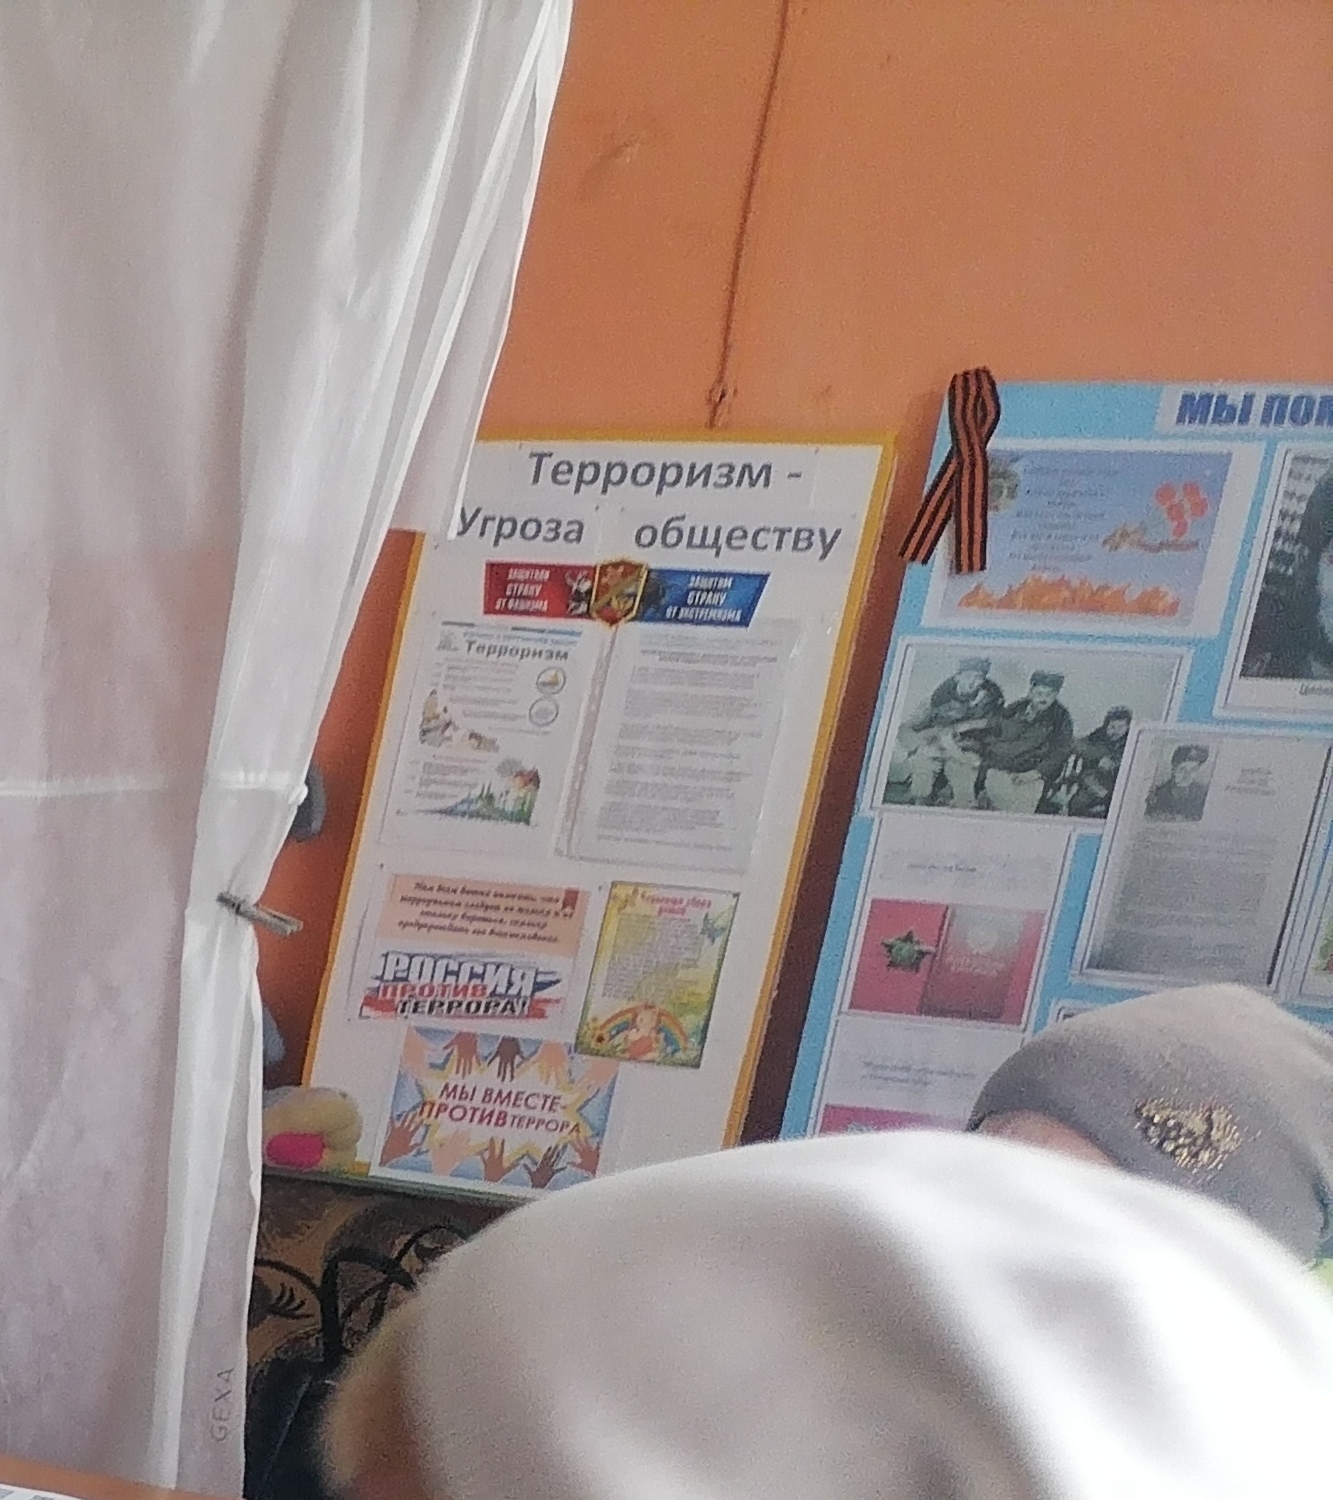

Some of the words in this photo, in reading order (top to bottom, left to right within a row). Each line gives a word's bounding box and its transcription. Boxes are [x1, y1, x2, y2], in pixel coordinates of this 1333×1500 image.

[1175, 391, 1256, 426] МЫ
[529, 450, 773, 496] Терроризм
[456, 505, 586, 546] Угроза
[634, 516, 843, 563] обществу
[686, 589, 728, 607] СТРАНУ
[465, 639, 570, 662] Терроризм
[377, 982, 489, 1001] ПРОТИВ
[382, 952, 538, 998] РОССИЯ
[438, 1082, 477, 1102] МЫ
[418, 1098, 508, 1127] ПРОТИВ
[509, 1115, 581, 1135] ТЕРРОРА
[209, 1366, 236, 1443] GEXA
